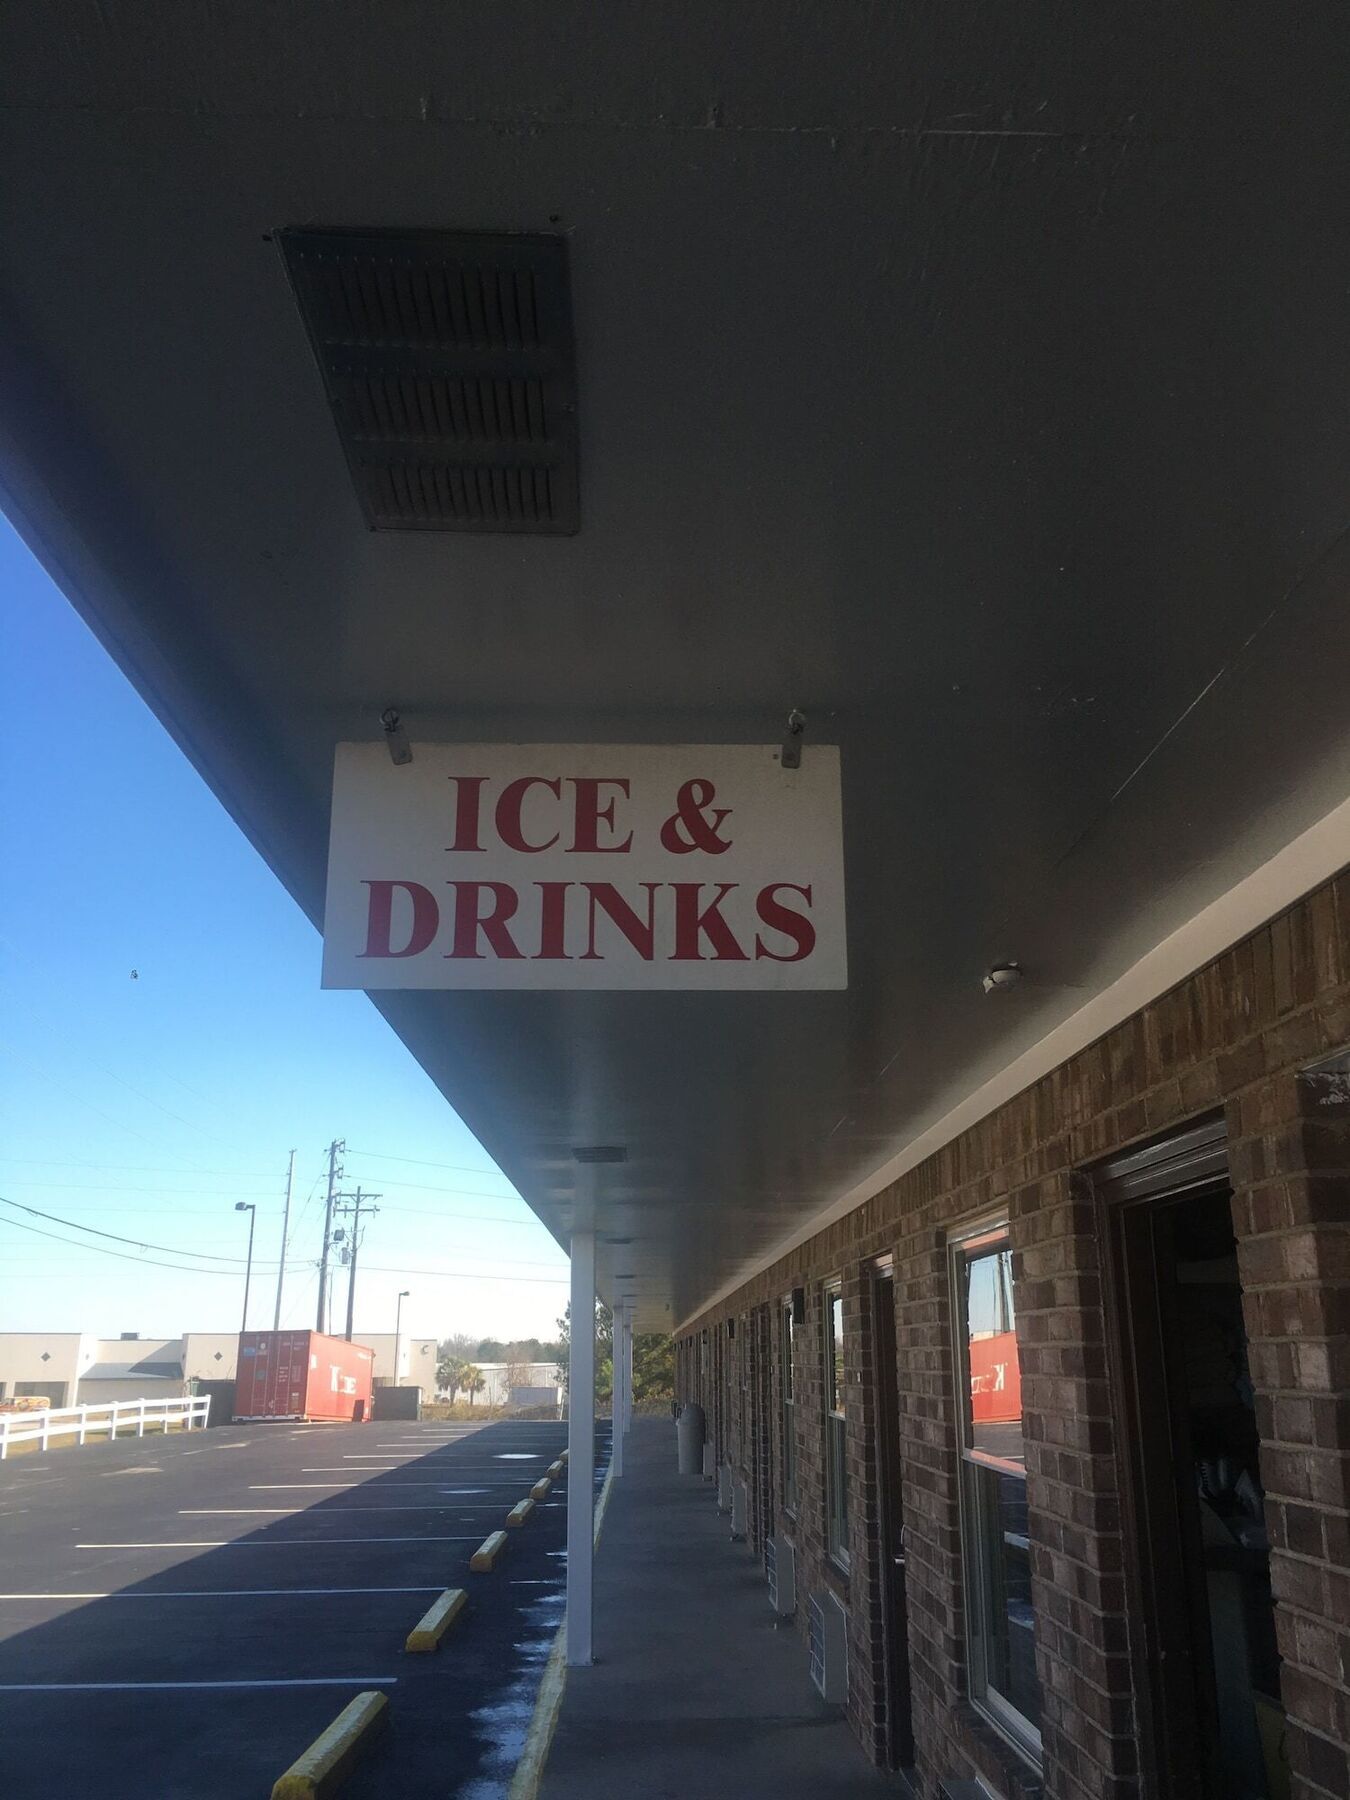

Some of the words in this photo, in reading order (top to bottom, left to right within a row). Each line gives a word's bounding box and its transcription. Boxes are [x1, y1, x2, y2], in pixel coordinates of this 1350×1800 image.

[444, 776, 634, 854] ICE
[659, 777, 734, 855] &
[355, 879, 817, 962] DRINKS
